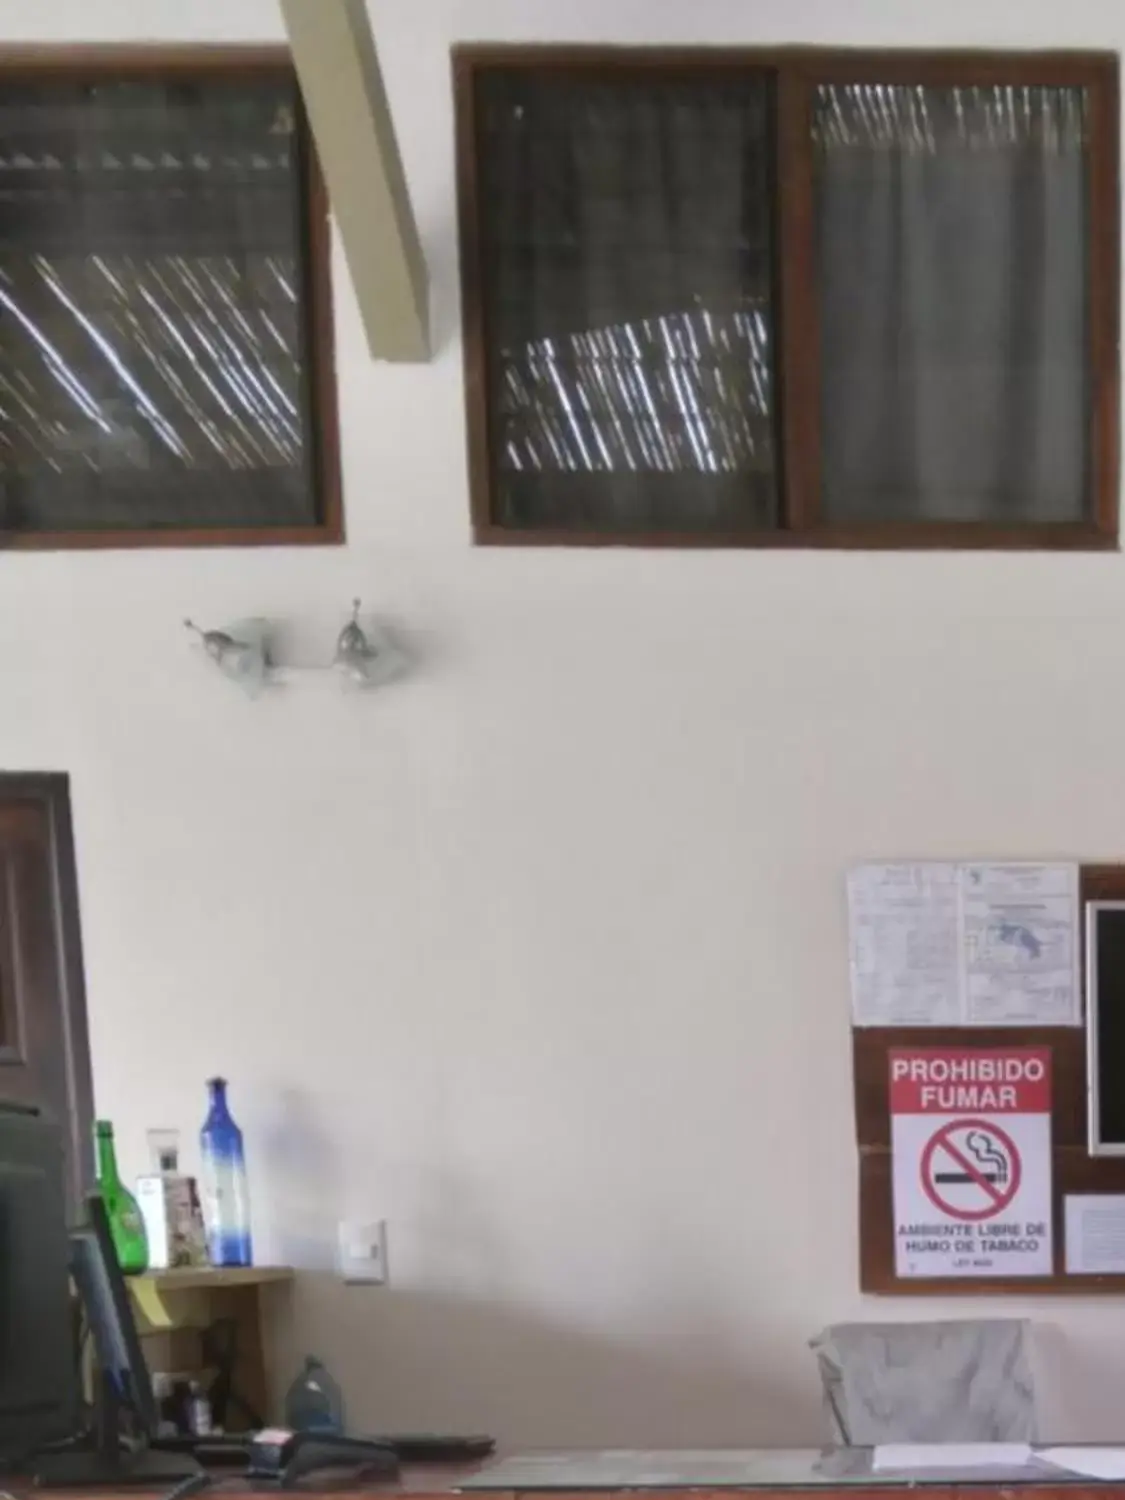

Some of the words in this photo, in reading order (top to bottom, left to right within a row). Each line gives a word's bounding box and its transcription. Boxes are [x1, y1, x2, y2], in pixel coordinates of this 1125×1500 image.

[892, 1057, 1045, 1082] PROHIBIDO
[920, 1084, 1018, 1109] FUMAR
[898, 1223, 972, 1236] AMBIENTE
[978, 1222, 1021, 1236] LIBRE
[1025, 1222, 1046, 1236] DE
[905, 1239, 950, 1253] HUMO
[954, 1239, 975, 1253] DE
[980, 1239, 1039, 1253] TABACO
